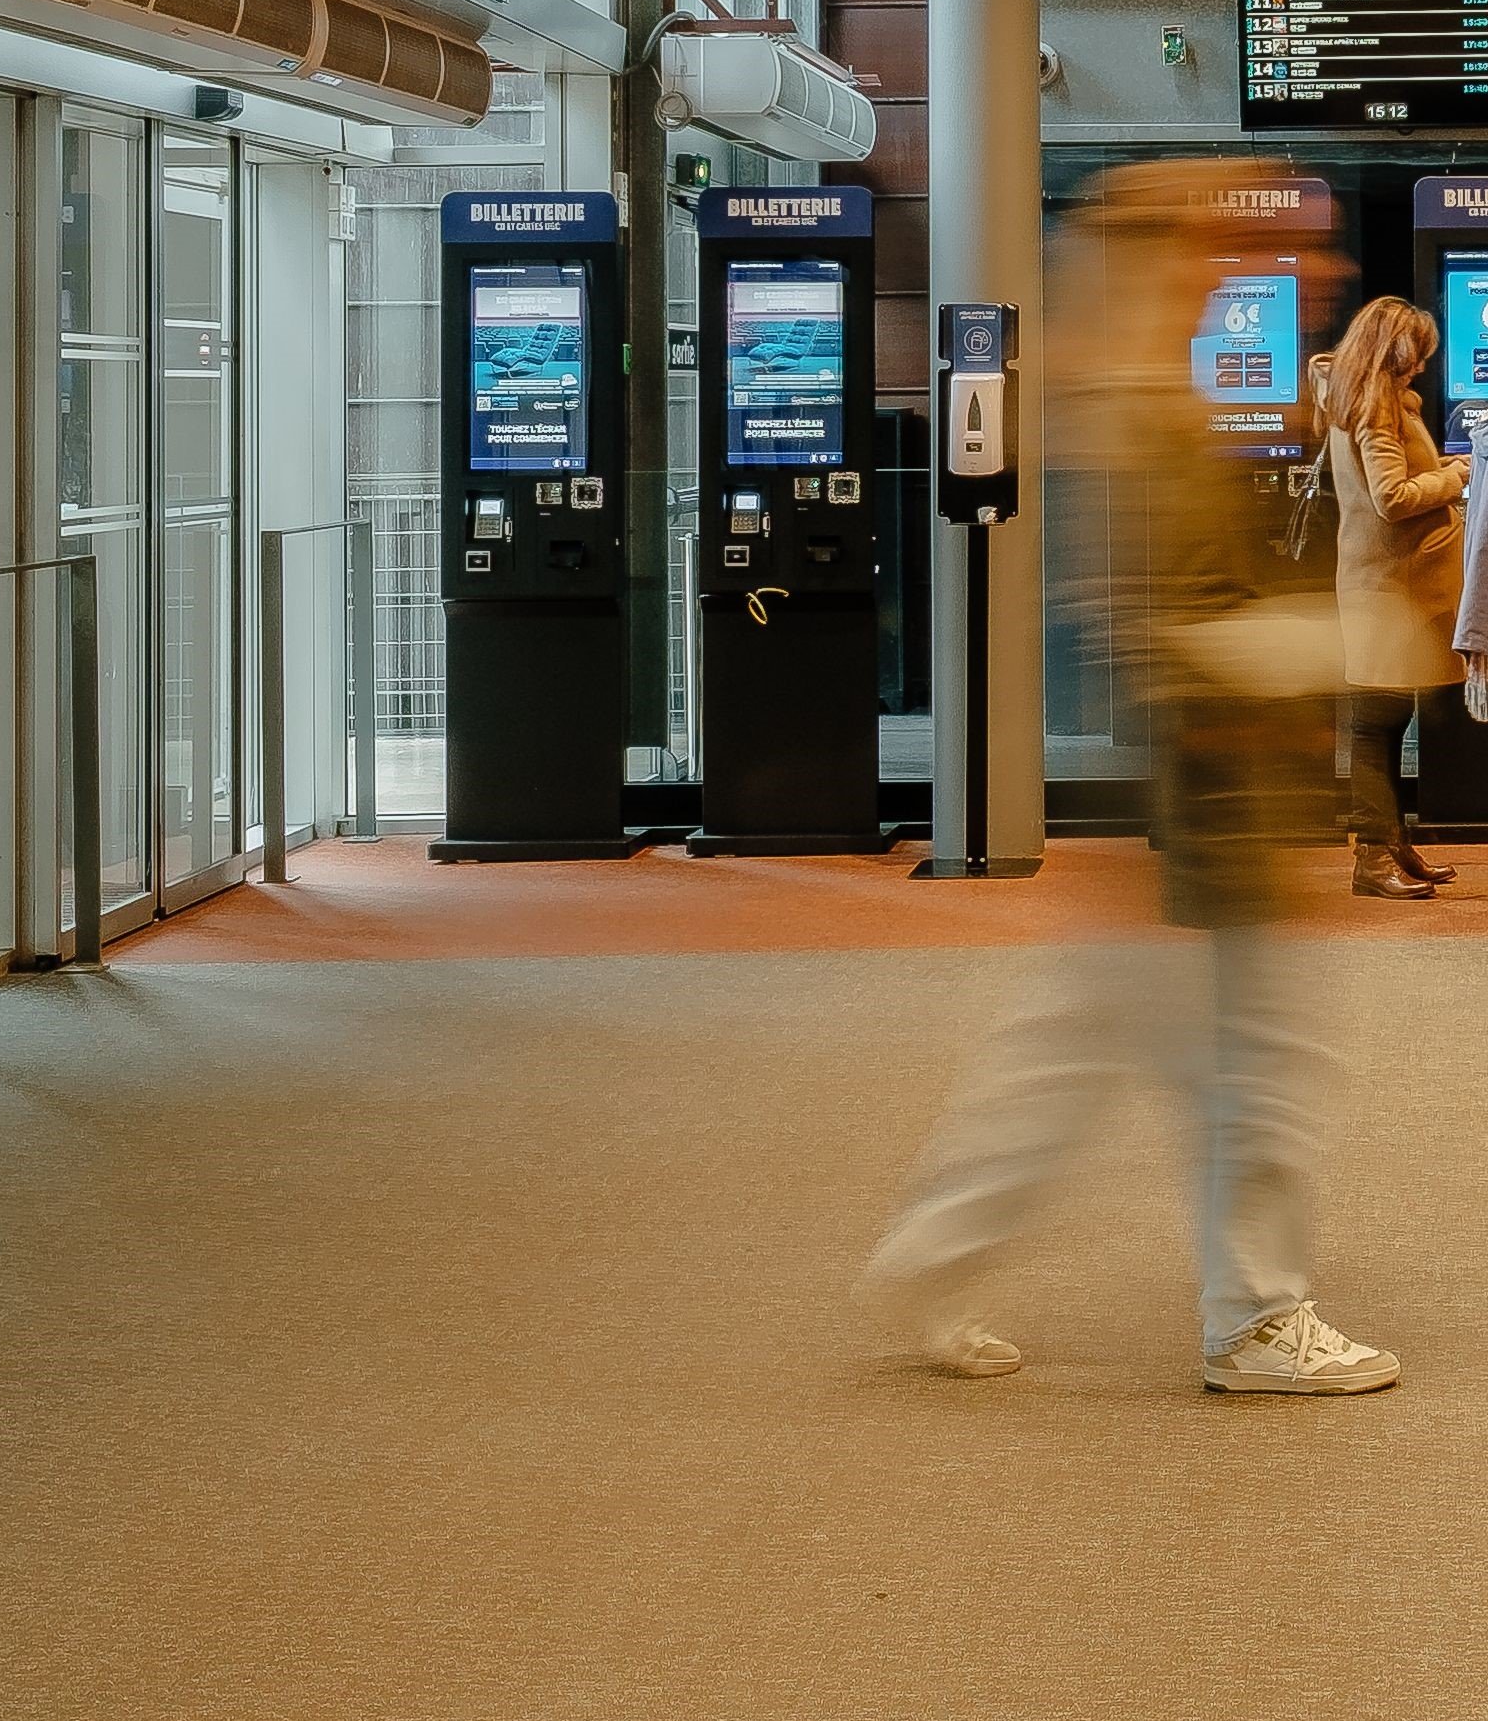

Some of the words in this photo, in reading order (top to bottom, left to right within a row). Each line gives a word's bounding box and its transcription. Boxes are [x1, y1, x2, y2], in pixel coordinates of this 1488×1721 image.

[1253, 18, 1273, 32] 12
[1254, 40, 1273, 54] 13
[1254, 63, 1273, 76] 14
[1255, 85, 1274, 98] 15
[1367, 105, 1386, 119] 15
[1389, 105, 1407, 119] 12
[471, 204, 584, 221] BILLETTERIE
[728, 198, 841, 216] BILLETTERIE
